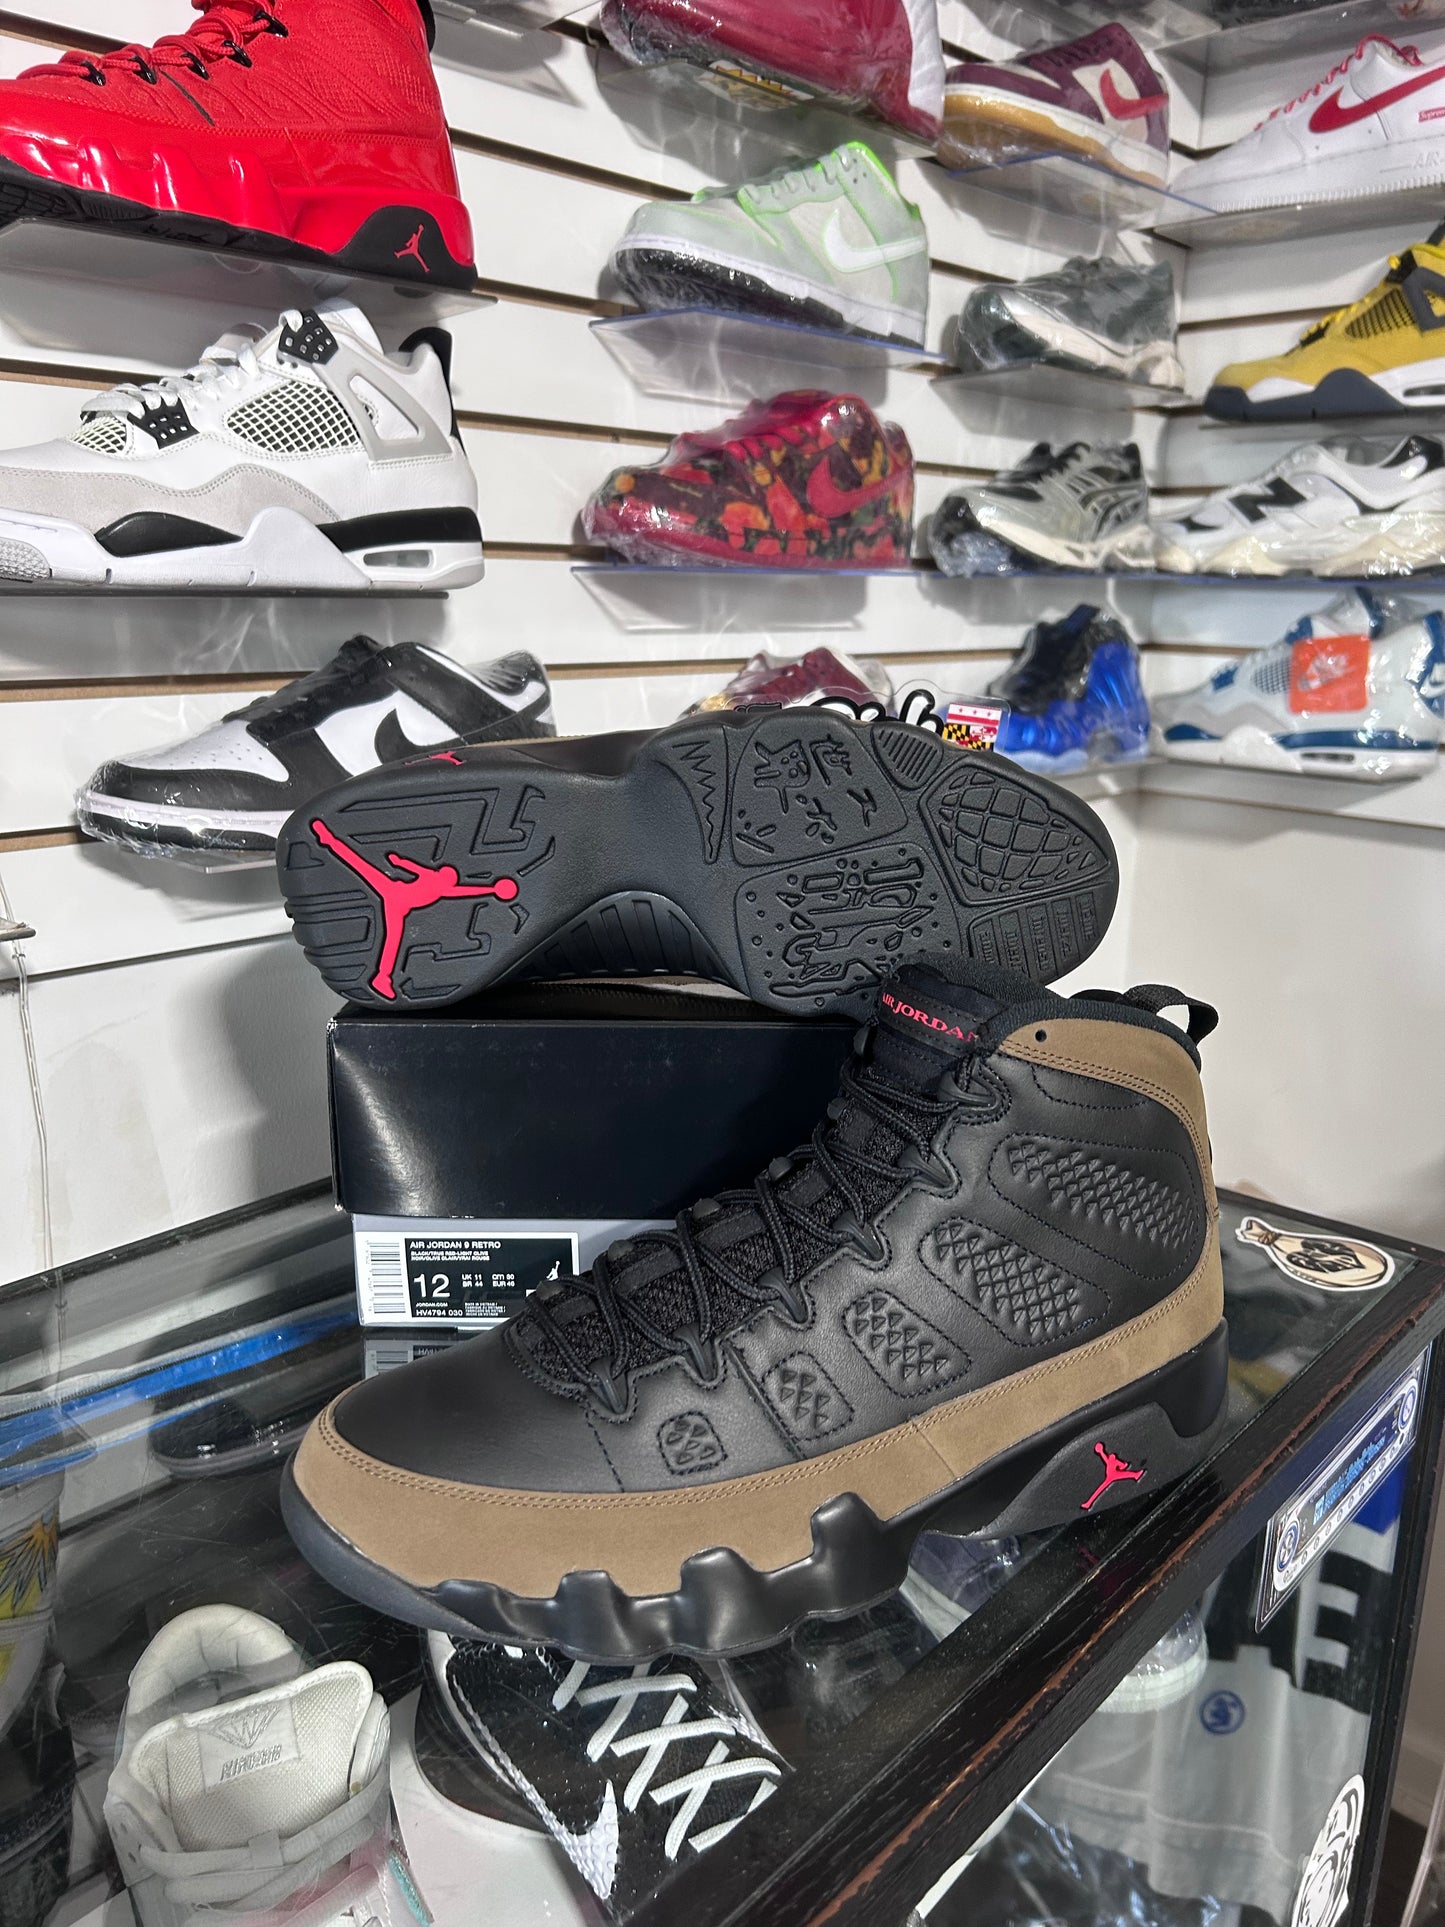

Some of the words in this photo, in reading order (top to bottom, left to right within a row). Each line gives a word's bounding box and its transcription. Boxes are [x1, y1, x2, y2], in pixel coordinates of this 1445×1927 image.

[410, 1240, 425, 1249] AIR
[426, 1240, 461, 1249] JORDAN
[464, 1240, 470, 1249] 9
[471, 1240, 501, 1249] RETRO
[461, 1273, 472, 1281] UK
[474, 1273, 482, 1281] 11
[413, 1273, 451, 1298] 12
[462, 1280, 473, 1288] BR
[474, 1280, 484, 1288] 44
[492, 1280, 507, 1288] EUR
[448, 1309, 463, 1317] 030
